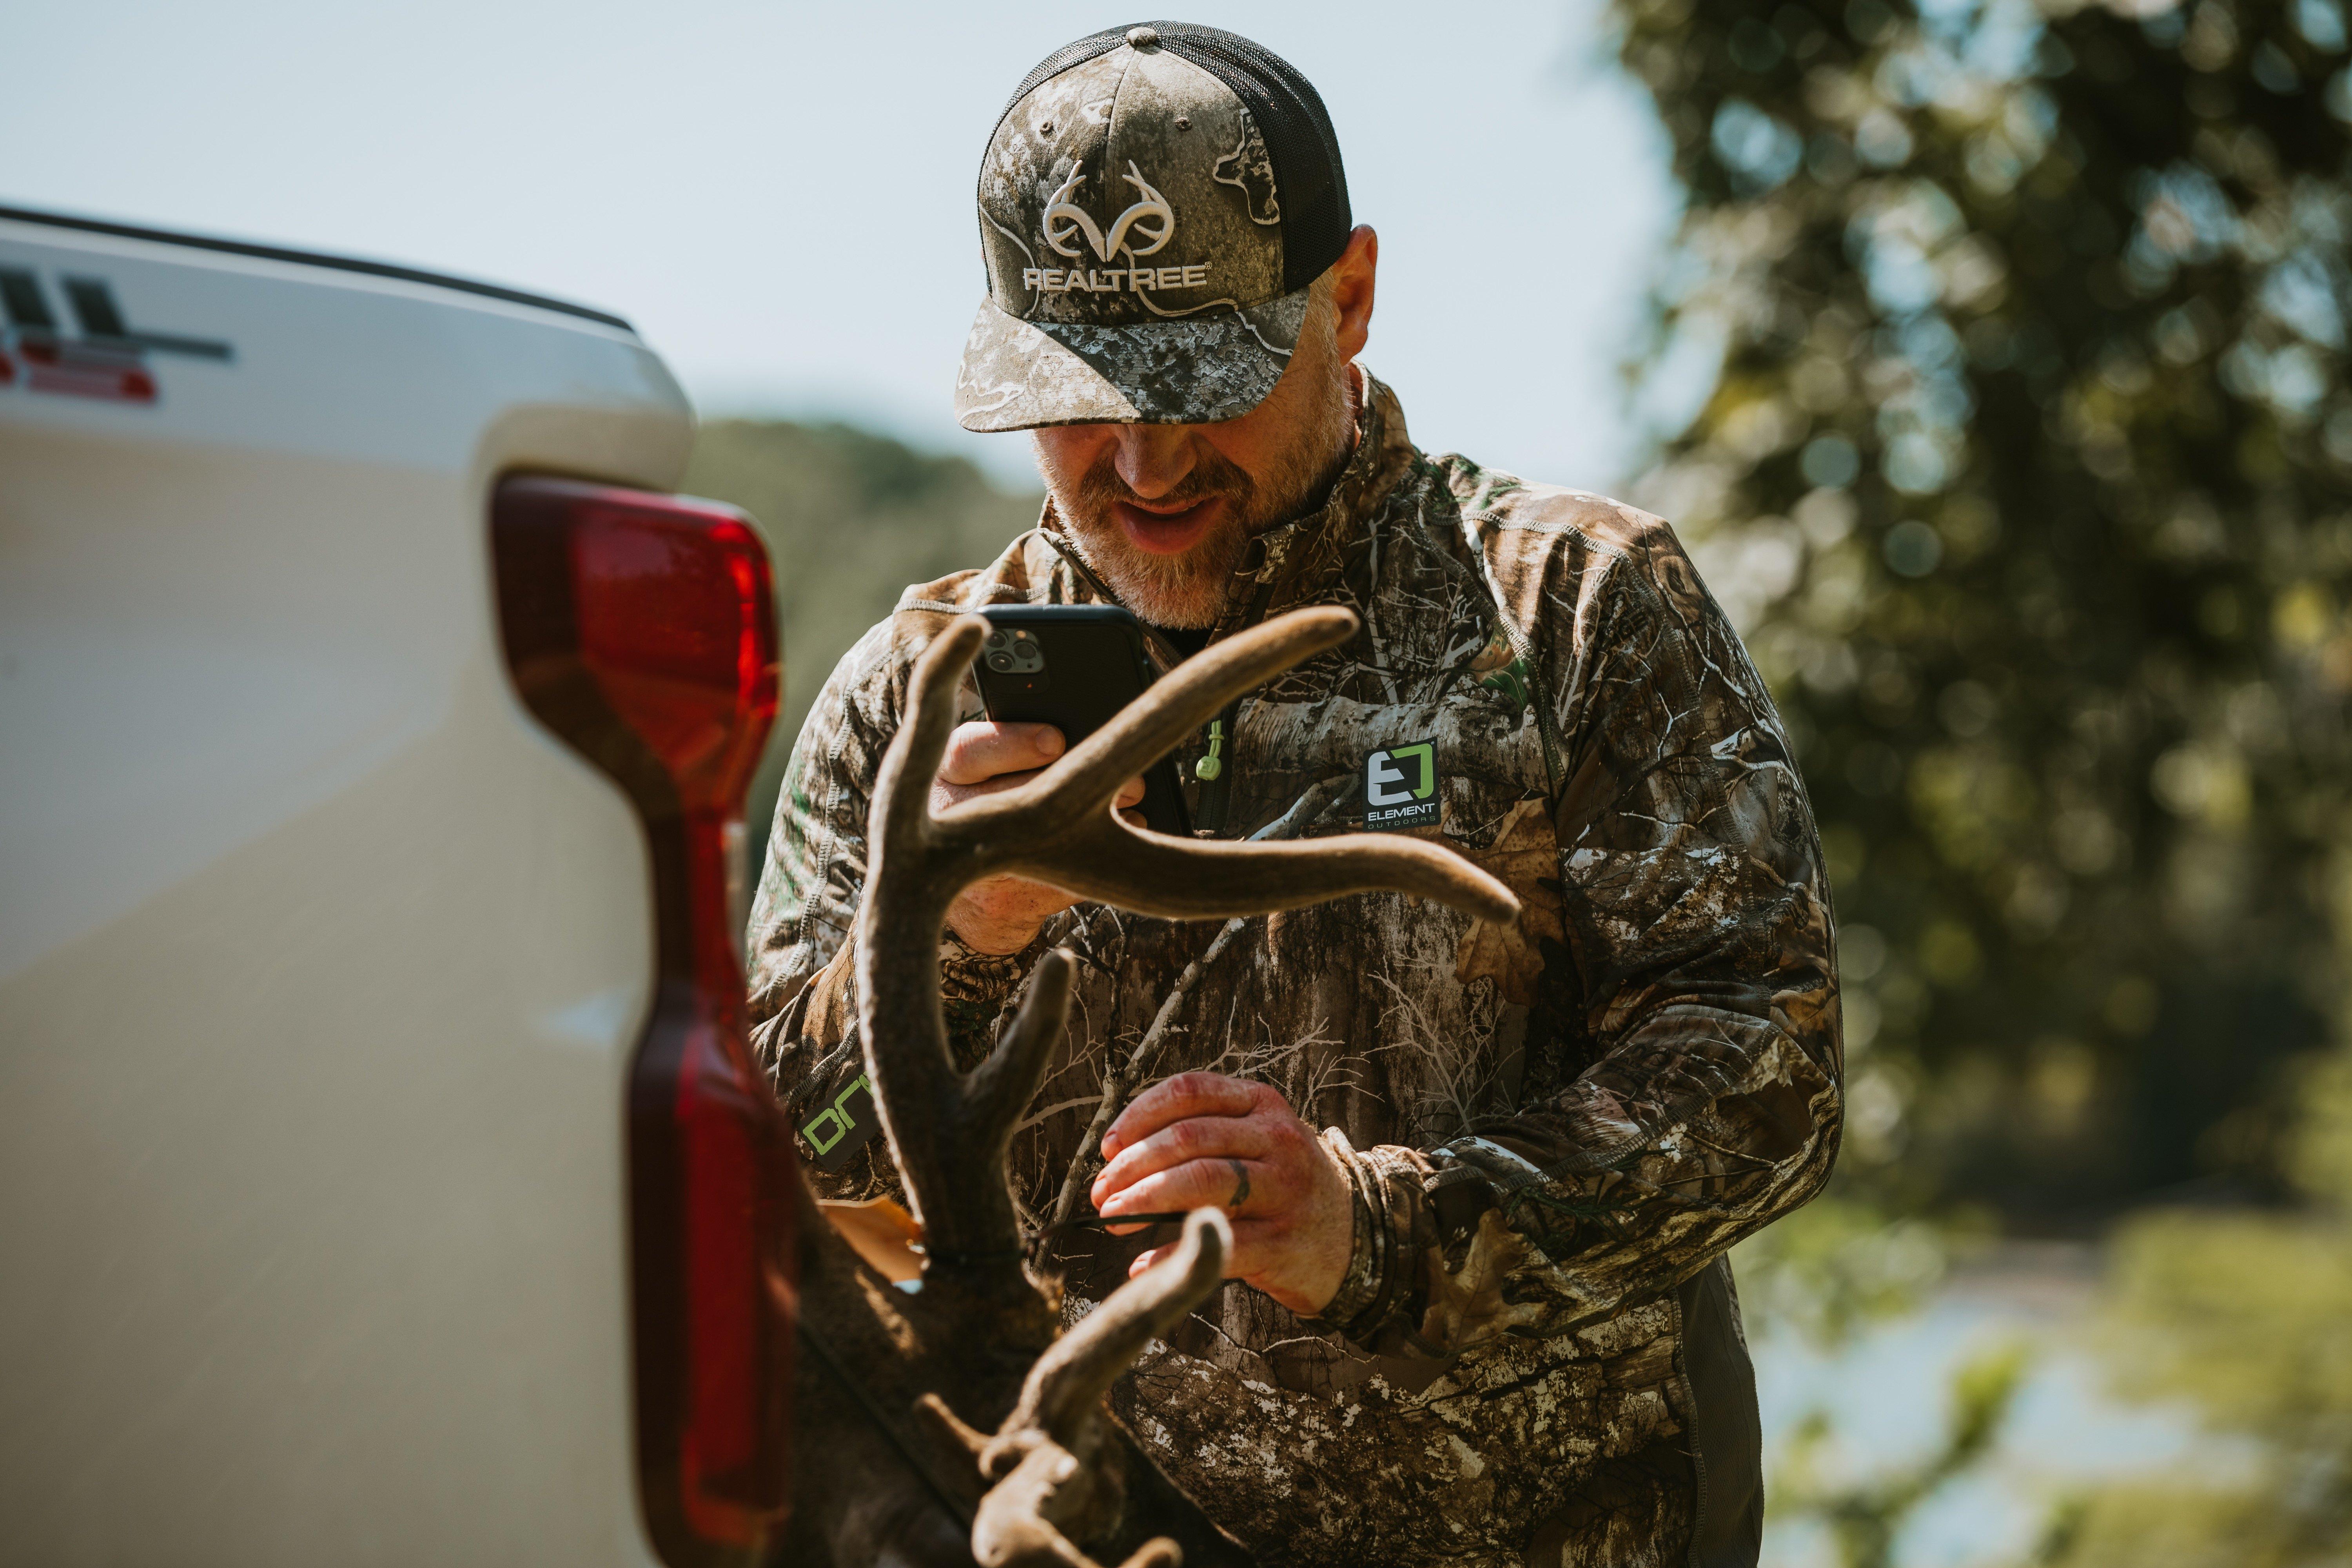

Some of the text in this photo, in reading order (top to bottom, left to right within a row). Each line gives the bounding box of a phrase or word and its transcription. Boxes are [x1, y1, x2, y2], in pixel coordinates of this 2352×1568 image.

[1023, 265, 1207, 292] REALTREE
[1368, 803, 1435, 821] ELEMENT
[1368, 816, 1436, 829] OUTDOORS
